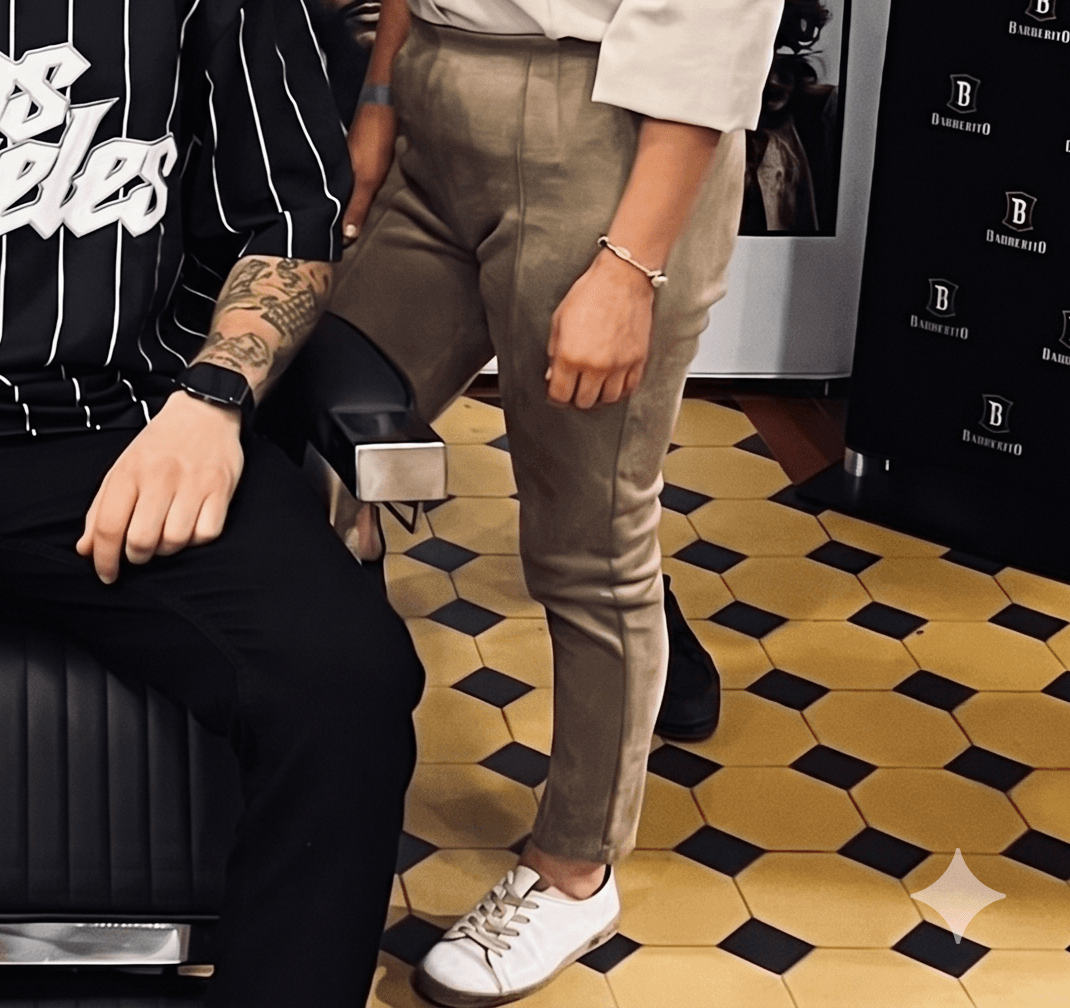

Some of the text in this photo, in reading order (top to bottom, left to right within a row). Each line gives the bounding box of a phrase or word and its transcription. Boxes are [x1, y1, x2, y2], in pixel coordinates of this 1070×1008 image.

[956, 80, 972, 107] B
[1011, 197, 1027, 225] B
[934, 284, 949, 311] B
[988, 400, 1003, 427] B
